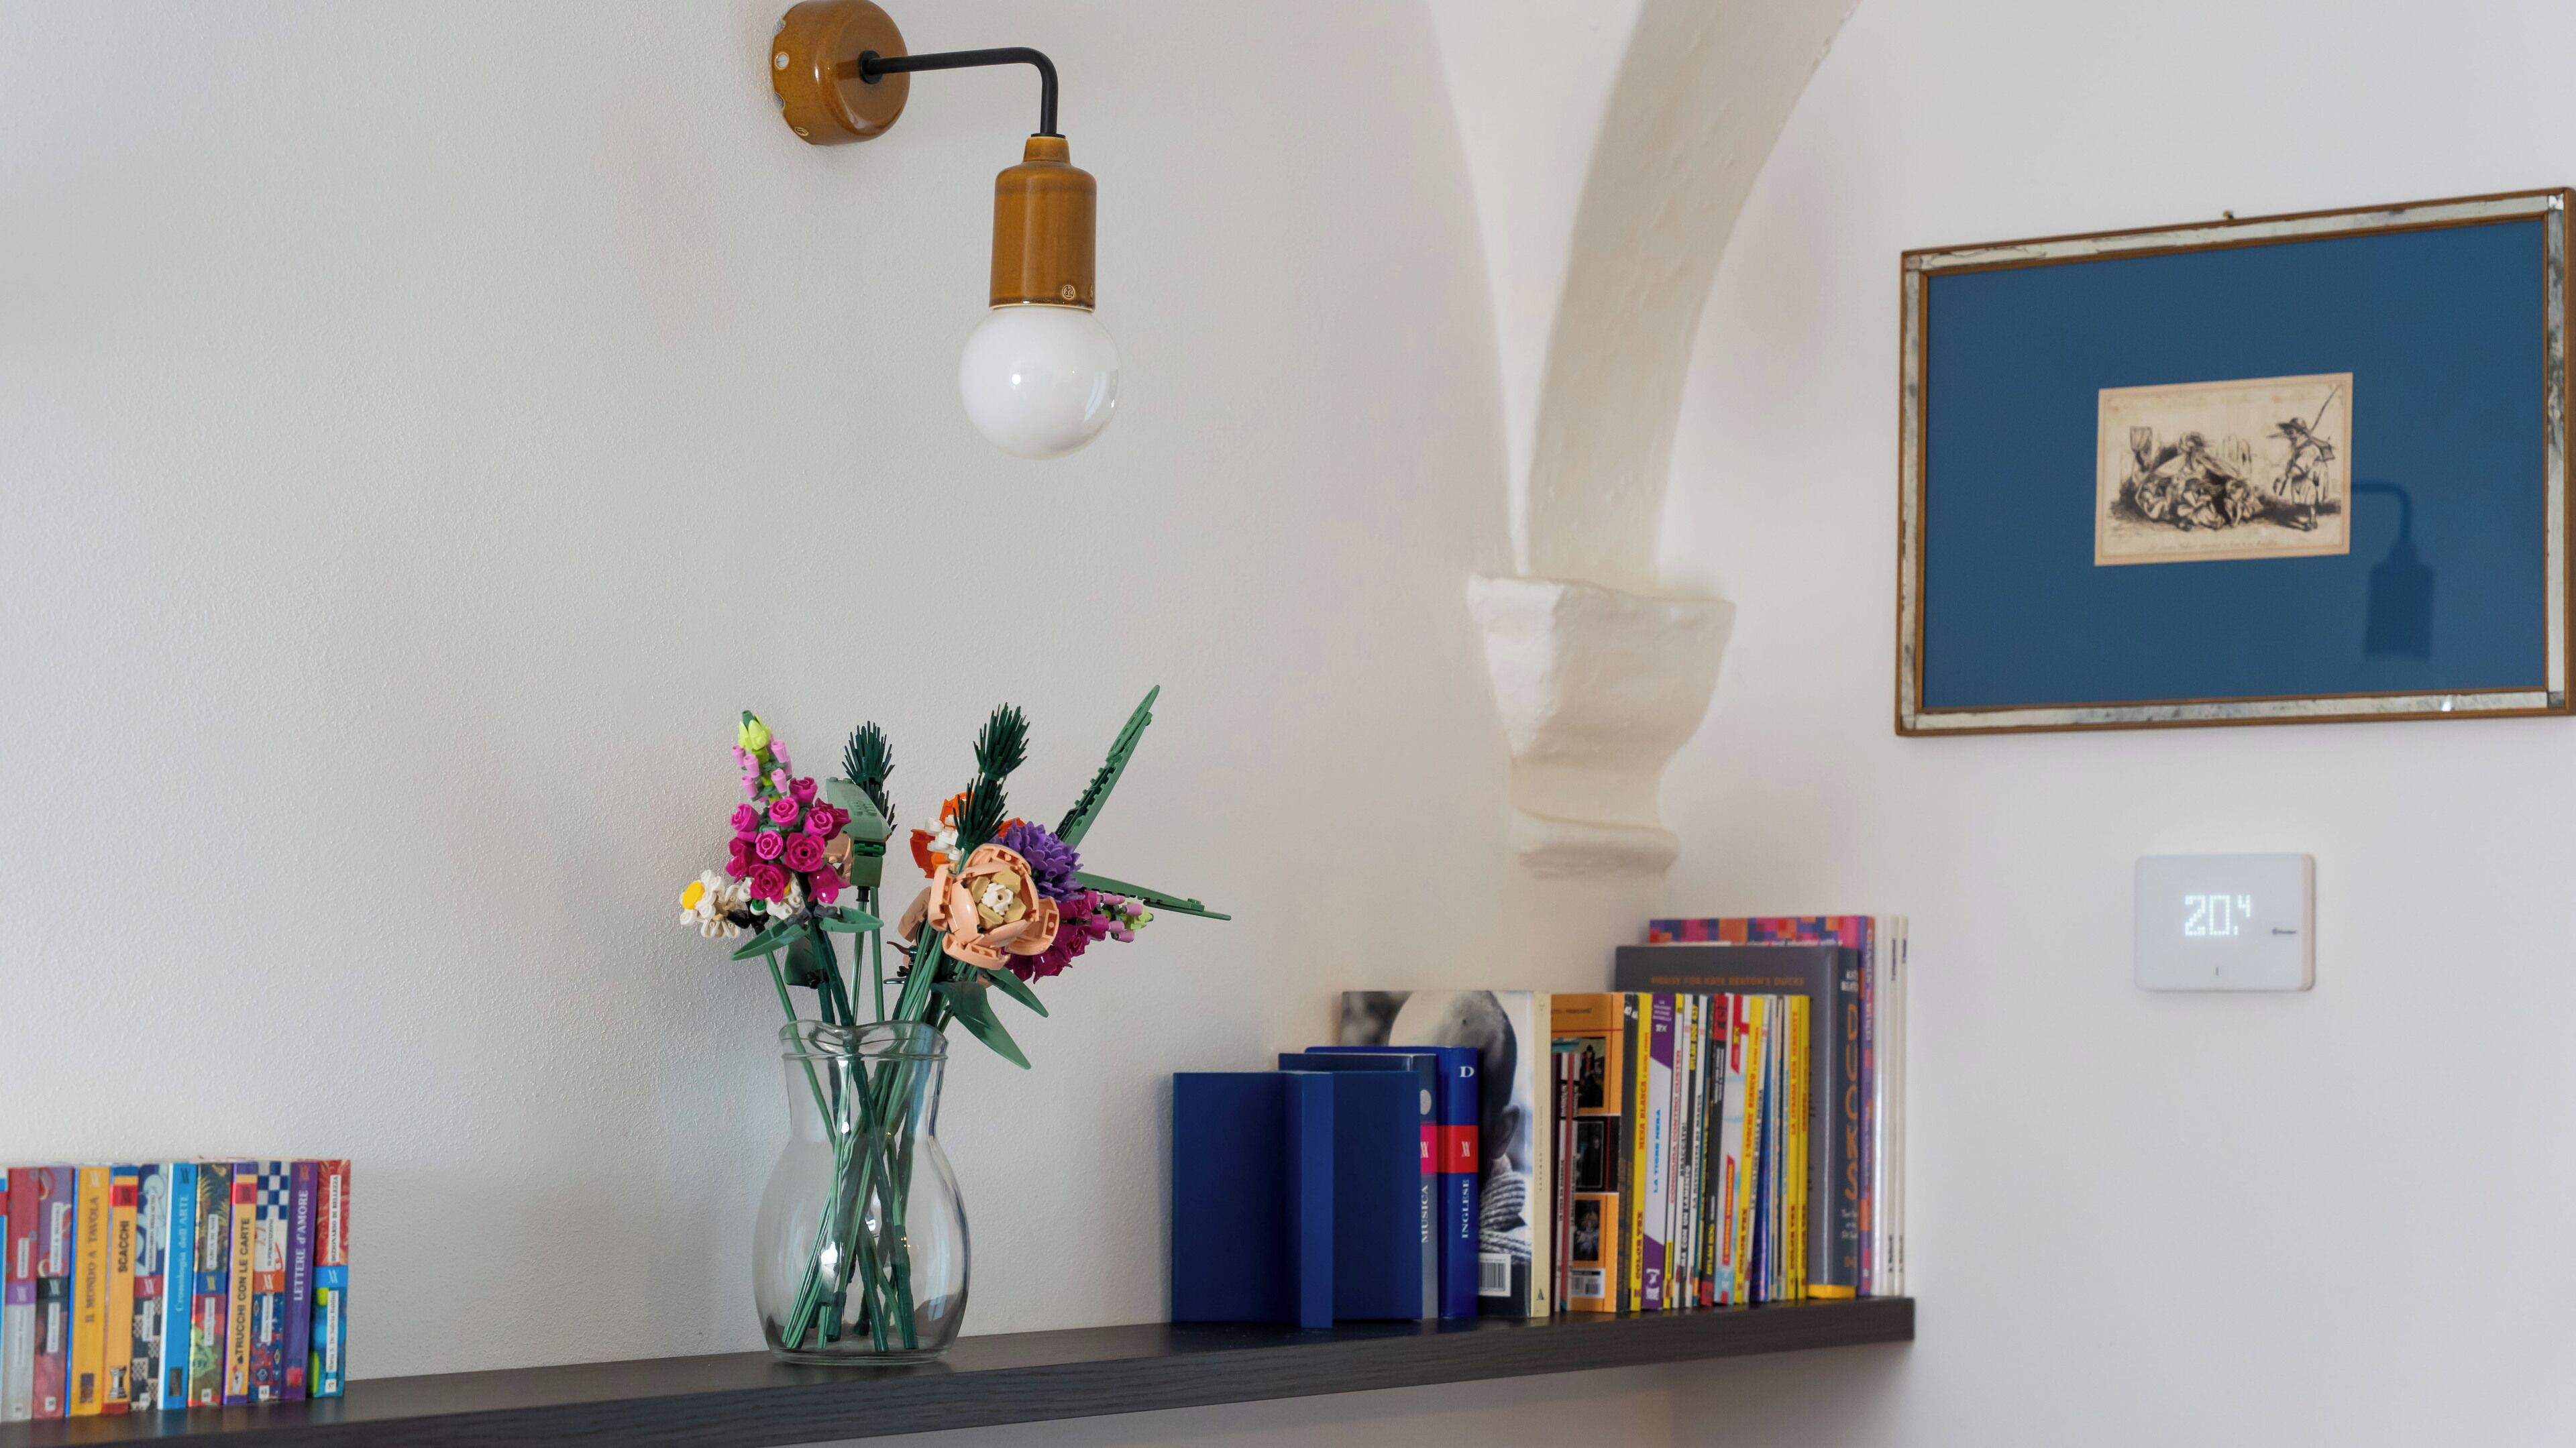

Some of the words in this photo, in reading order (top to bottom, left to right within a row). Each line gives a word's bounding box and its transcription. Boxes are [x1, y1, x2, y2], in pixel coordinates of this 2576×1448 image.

[1460, 1066, 1474, 1078] D
[1461, 1179, 1470, 1238] INGLESE
[1654, 1180, 1658, 1192] LA
[88, 1196, 99, 1243] TAVOLA
[239, 1218, 250, 1255] CARTE
[296, 1190, 309, 1245] d'AMORE
[1421, 1185, 1429, 1243] MUSICA
[1682, 1213, 1688, 1225] UN
[118, 1221, 129, 1272] SCACCHI
[330, 1221, 338, 1262] DIZIONARIO
[85, 1263, 97, 1308] MONDO
[175, 1252, 187, 1311] Cronologia
[237, 1277, 248, 1300] CON
[239, 1260, 248, 1272] LE
[293, 1249, 306, 1301] LETTERE
[85, 1314, 94, 1323] IL
[234, 1304, 246, 1355] TRUCCHI
